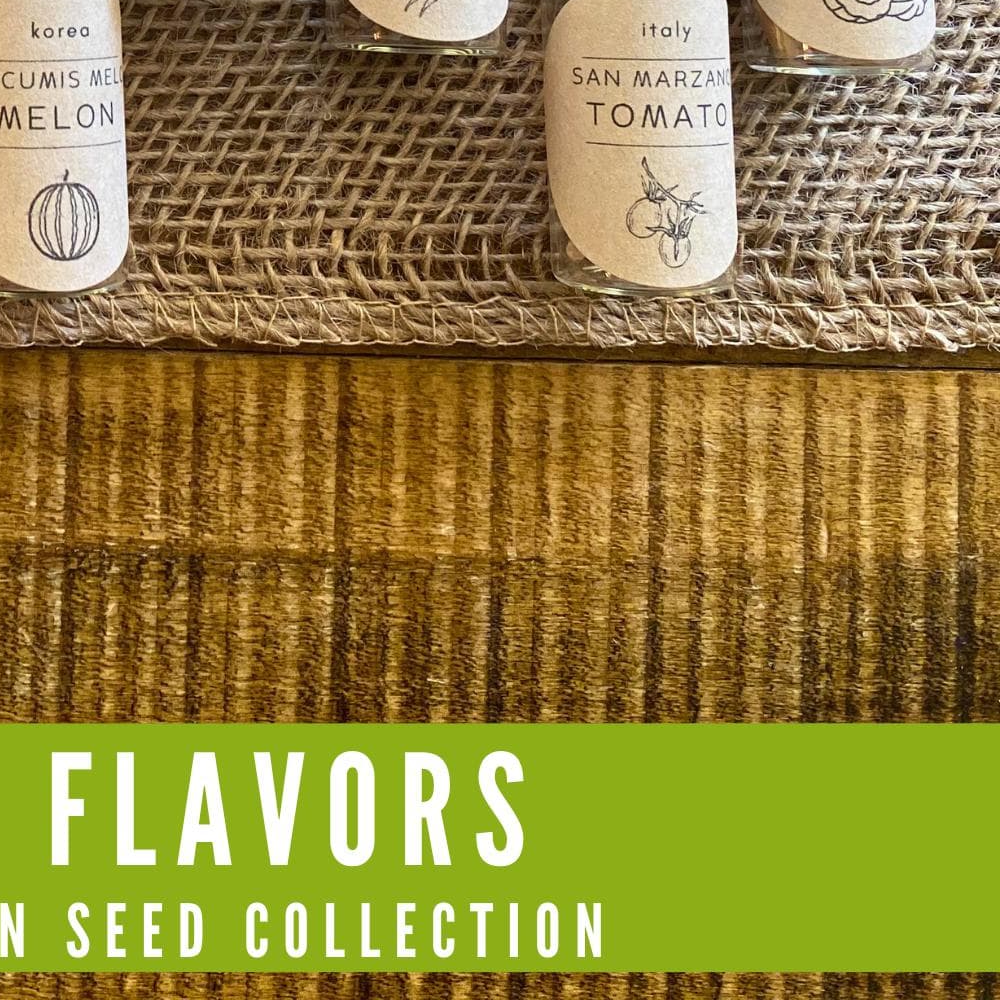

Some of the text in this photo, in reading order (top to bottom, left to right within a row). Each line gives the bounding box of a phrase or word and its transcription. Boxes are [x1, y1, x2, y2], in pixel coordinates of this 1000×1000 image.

[31, 21, 90, 38] korea
[642, 21, 692, 42] italy
[572, 67, 620, 87] SAN
[587, 102, 727, 128] TOMATO
